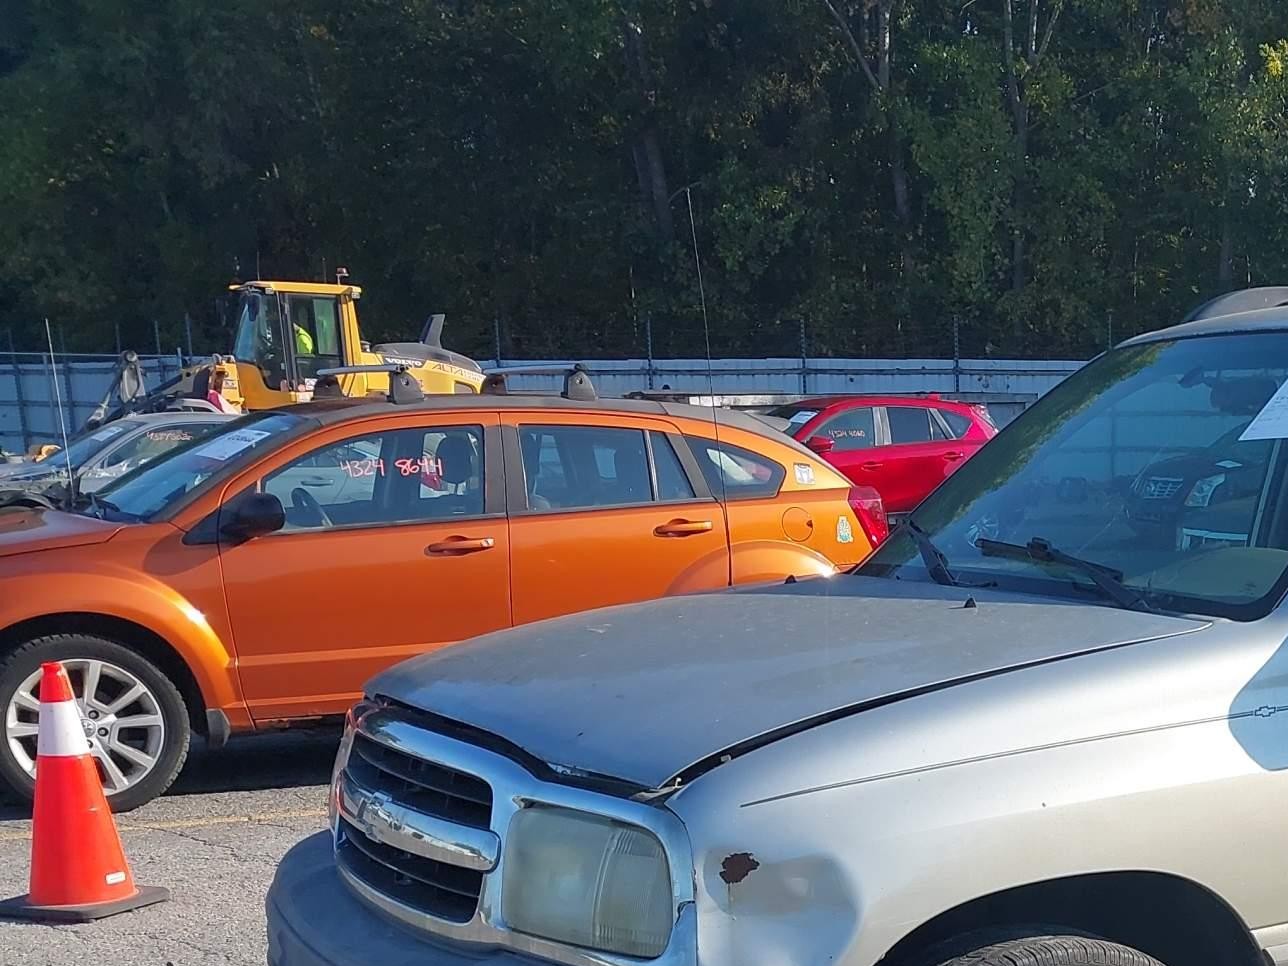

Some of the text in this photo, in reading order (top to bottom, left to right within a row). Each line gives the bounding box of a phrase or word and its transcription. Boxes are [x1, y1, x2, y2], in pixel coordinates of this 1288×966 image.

[384, 357, 422, 366] VOLVO
[432, 363, 463, 377] ALTA
[340, 458, 443, 478] 4324 8644
